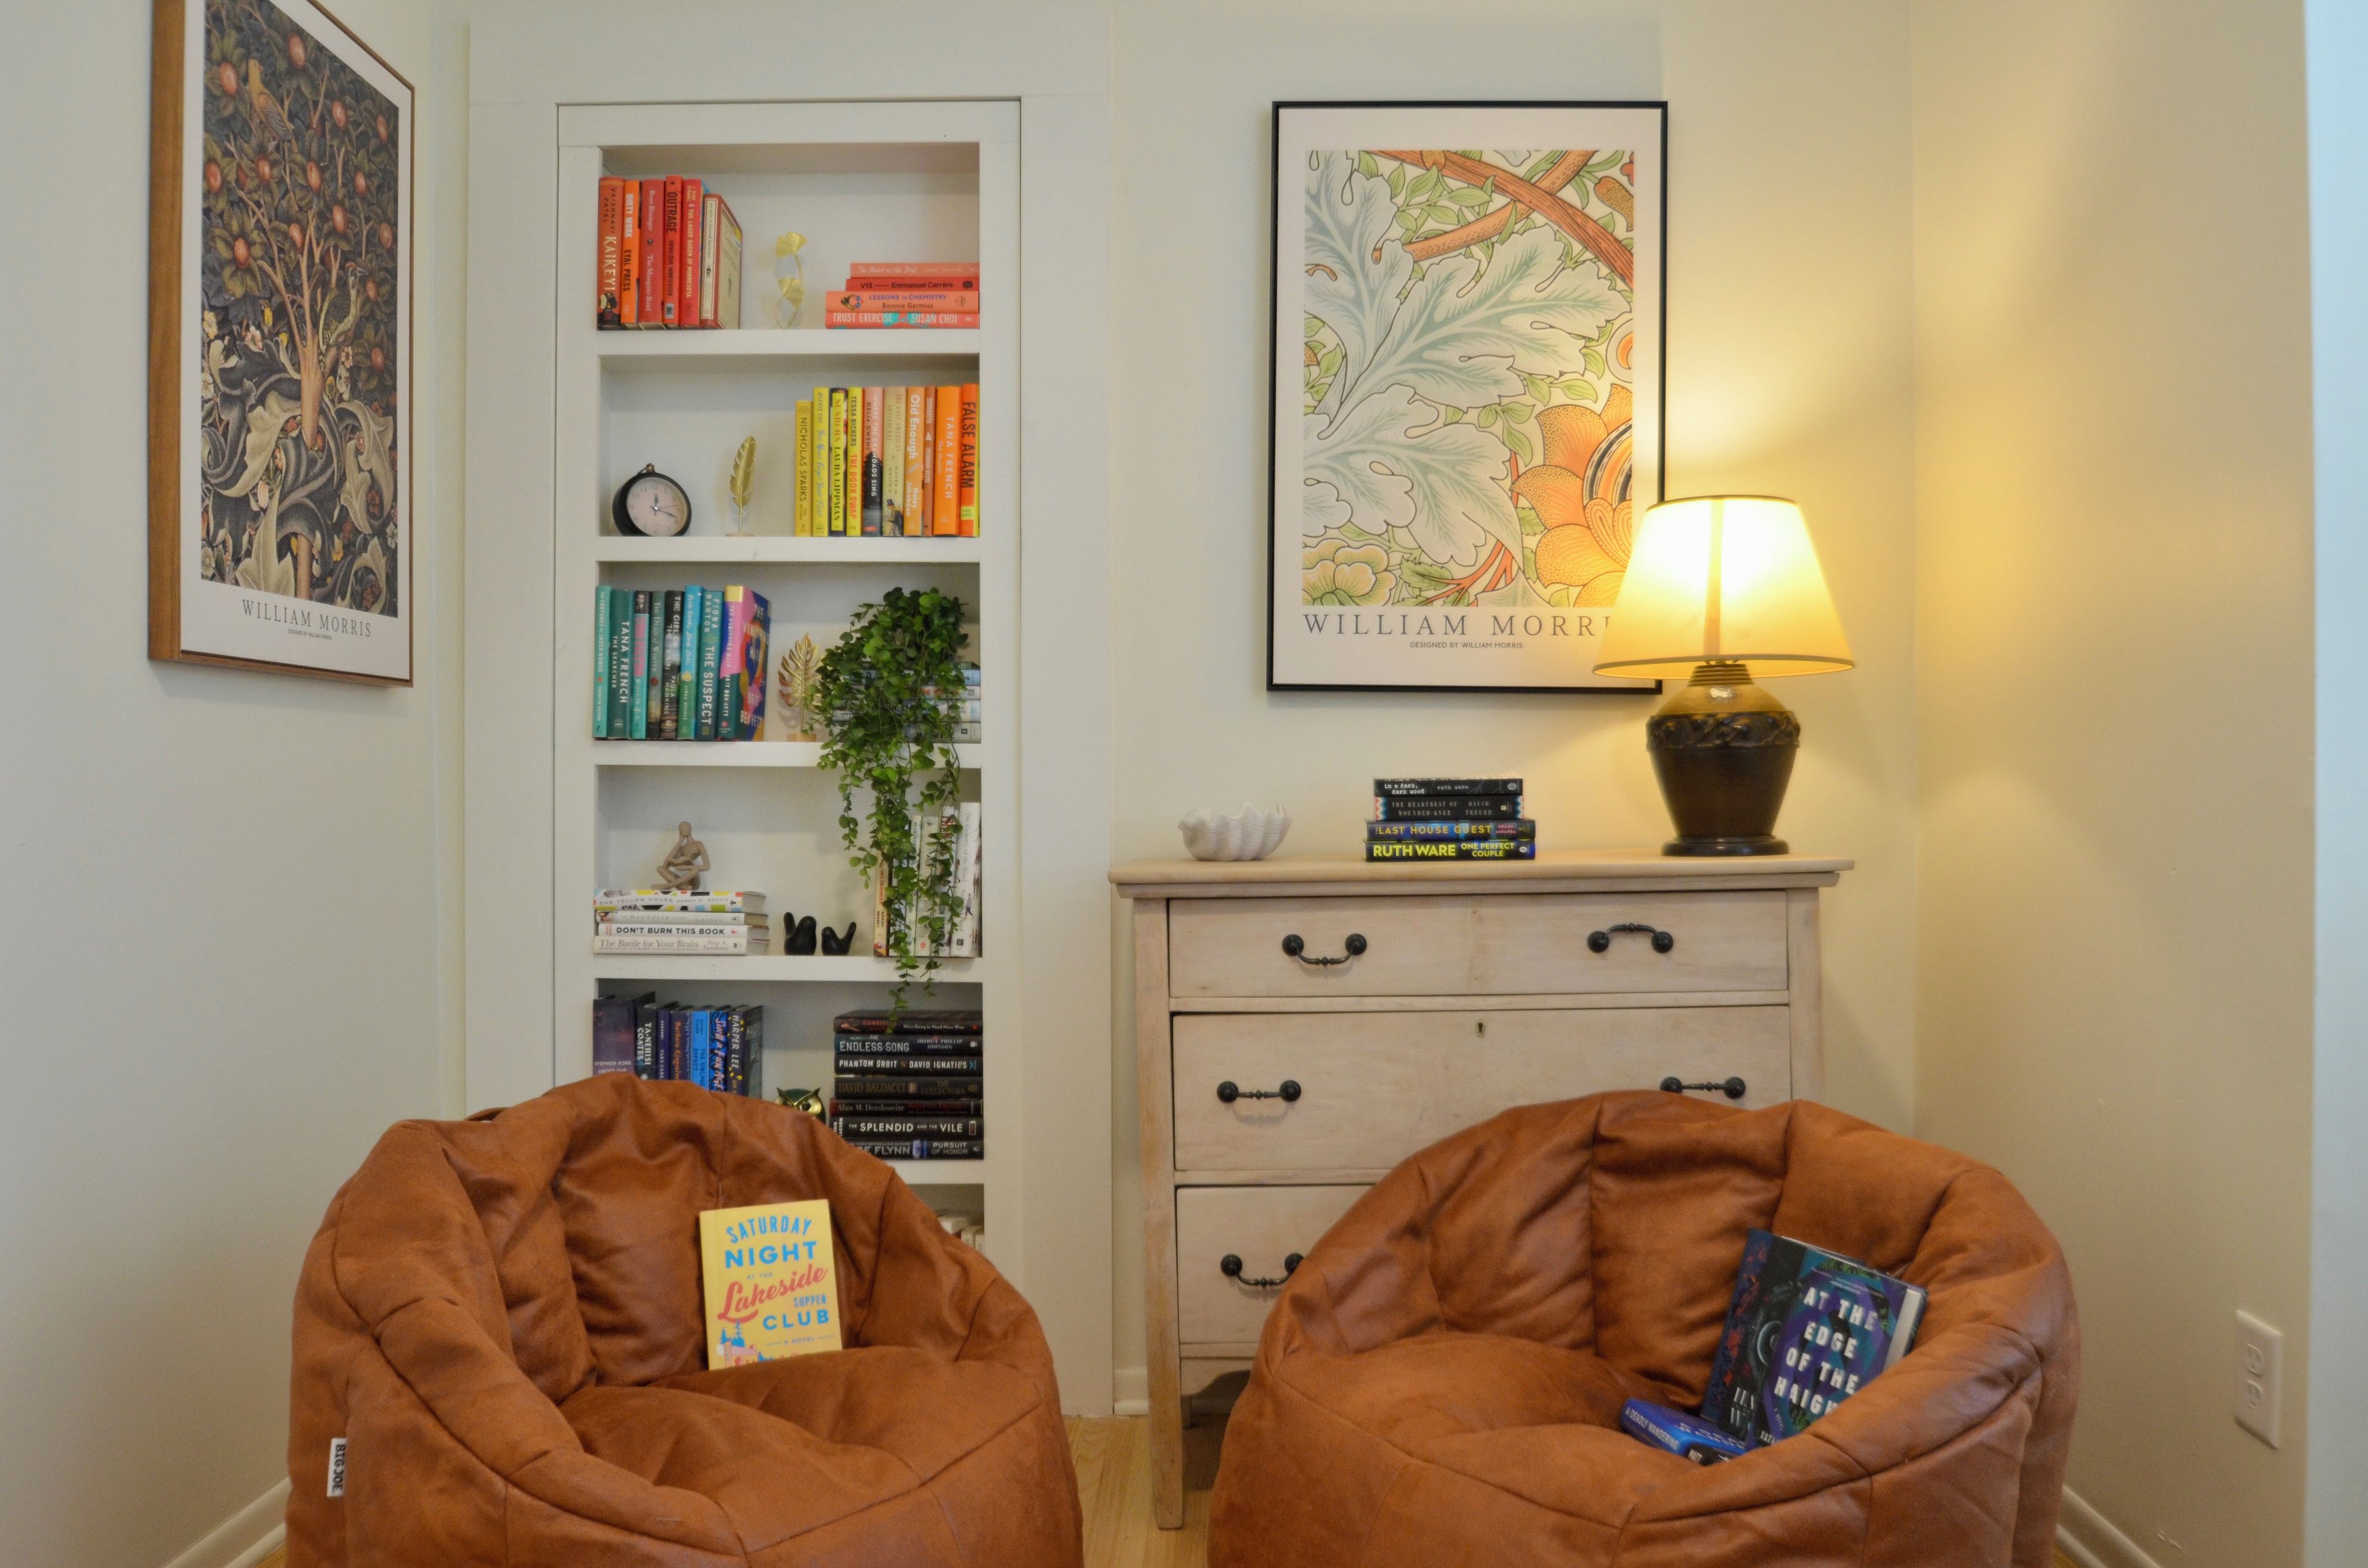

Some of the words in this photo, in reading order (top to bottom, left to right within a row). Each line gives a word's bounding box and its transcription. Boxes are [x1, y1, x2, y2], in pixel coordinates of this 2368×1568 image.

[625, 194, 634, 215] DIRTY
[667, 192, 677, 233] OUTRAGE
[625, 217, 633, 238] WORK
[603, 236, 617, 290] KAIKEYI
[623, 249, 631, 265] EYAL
[623, 269, 631, 292] PRESS
[832, 313, 856, 323] TRUST
[859, 313, 892, 323] EXERCISE
[910, 313, 936, 324] SUSAN
[939, 313, 957, 324] CHOI
[910, 394, 920, 414] Old
[961, 401, 976, 438] FALSE
[799, 417, 808, 466] NICHOLAS
[906, 417, 919, 459] Enough
[946, 417, 955, 447] TANA
[850, 454, 858, 470] THE
[961, 443, 976, 489] ALARM
[799, 470, 807, 502] SPARKS
[849, 472, 858, 494] BOOK
[945, 454, 954, 499] FRENCH
[849, 495, 858, 519] SWAP
[911, 488, 919, 509] Haley
[673, 596, 681, 611] THE
[711, 598, 720, 629] FIONA
[242, 599, 311, 628] WILLIAM
[319, 614, 371, 638] MORRIS
[672, 615, 680, 633] GIRL
[1302, 614, 1467, 635] WILLIAM
[1491, 615, 1611, 636] MORRI
[620, 621, 630, 652] TANA
[704, 646, 715, 668] THE
[619, 659, 628, 704] FRENCH
[669, 675, 677, 697] PAULA
[663, 682, 671, 715] HAWKINS
[701, 673, 713, 725] SUSPECT
[1410, 826, 1448, 834] HOUSE
[1454, 826, 1492, 834] GUEST
[1373, 845, 1414, 856] RUTH
[1415, 845, 1456, 856] WARE
[599, 939, 616, 947] The
[618, 940, 641, 948] Battle
[643, 940, 654, 948] for
[656, 940, 675, 948] Your
[677, 940, 699, 948] Brain
[731, 1015, 739, 1049] HARPER
[637, 1027, 645, 1061] COATES
[839, 1041, 883, 1051] ENDLESS
[885, 1042, 910, 1052] SONG
[731, 1054, 739, 1069] LEE
[839, 1060, 873, 1068] PHANTOM
[876, 1060, 897, 1068] ORBIT
[909, 1061, 931, 1069] DAVID
[933, 1061, 967, 1069] IGNATIUS
[839, 1083, 863, 1093] DAVID
[865, 1083, 905, 1093] BALDACCI
[860, 1123, 914, 1132] SPLENDID
[940, 1123, 963, 1133] VILE
[874, 1146, 910, 1155] FLYNN
[726, 1215, 812, 1244] SATURDAY
[725, 1241, 816, 1268] NIGHT
[717, 1263, 828, 1324] Lakeside
[793, 1294, 827, 1308] SUPPER
[762, 1309, 829, 1331] CLUB
[1803, 1287, 1830, 1311] AT
[1838, 1299, 1878, 1331] THE
[792, 1336, 815, 1344] NOVEL
[1803, 1320, 1858, 1359] EDGE
[1786, 1347, 1811, 1373] OF
[1819, 1361, 1859, 1395] THE
[1774, 1376, 1839, 1415] HAIGH
[1629, 1410, 1649, 1429] DEADLY
[1648, 1421, 1680, 1451] WANDERING
[334, 1444, 346, 1467] BIG
[332, 1468, 343, 1493] JOE
